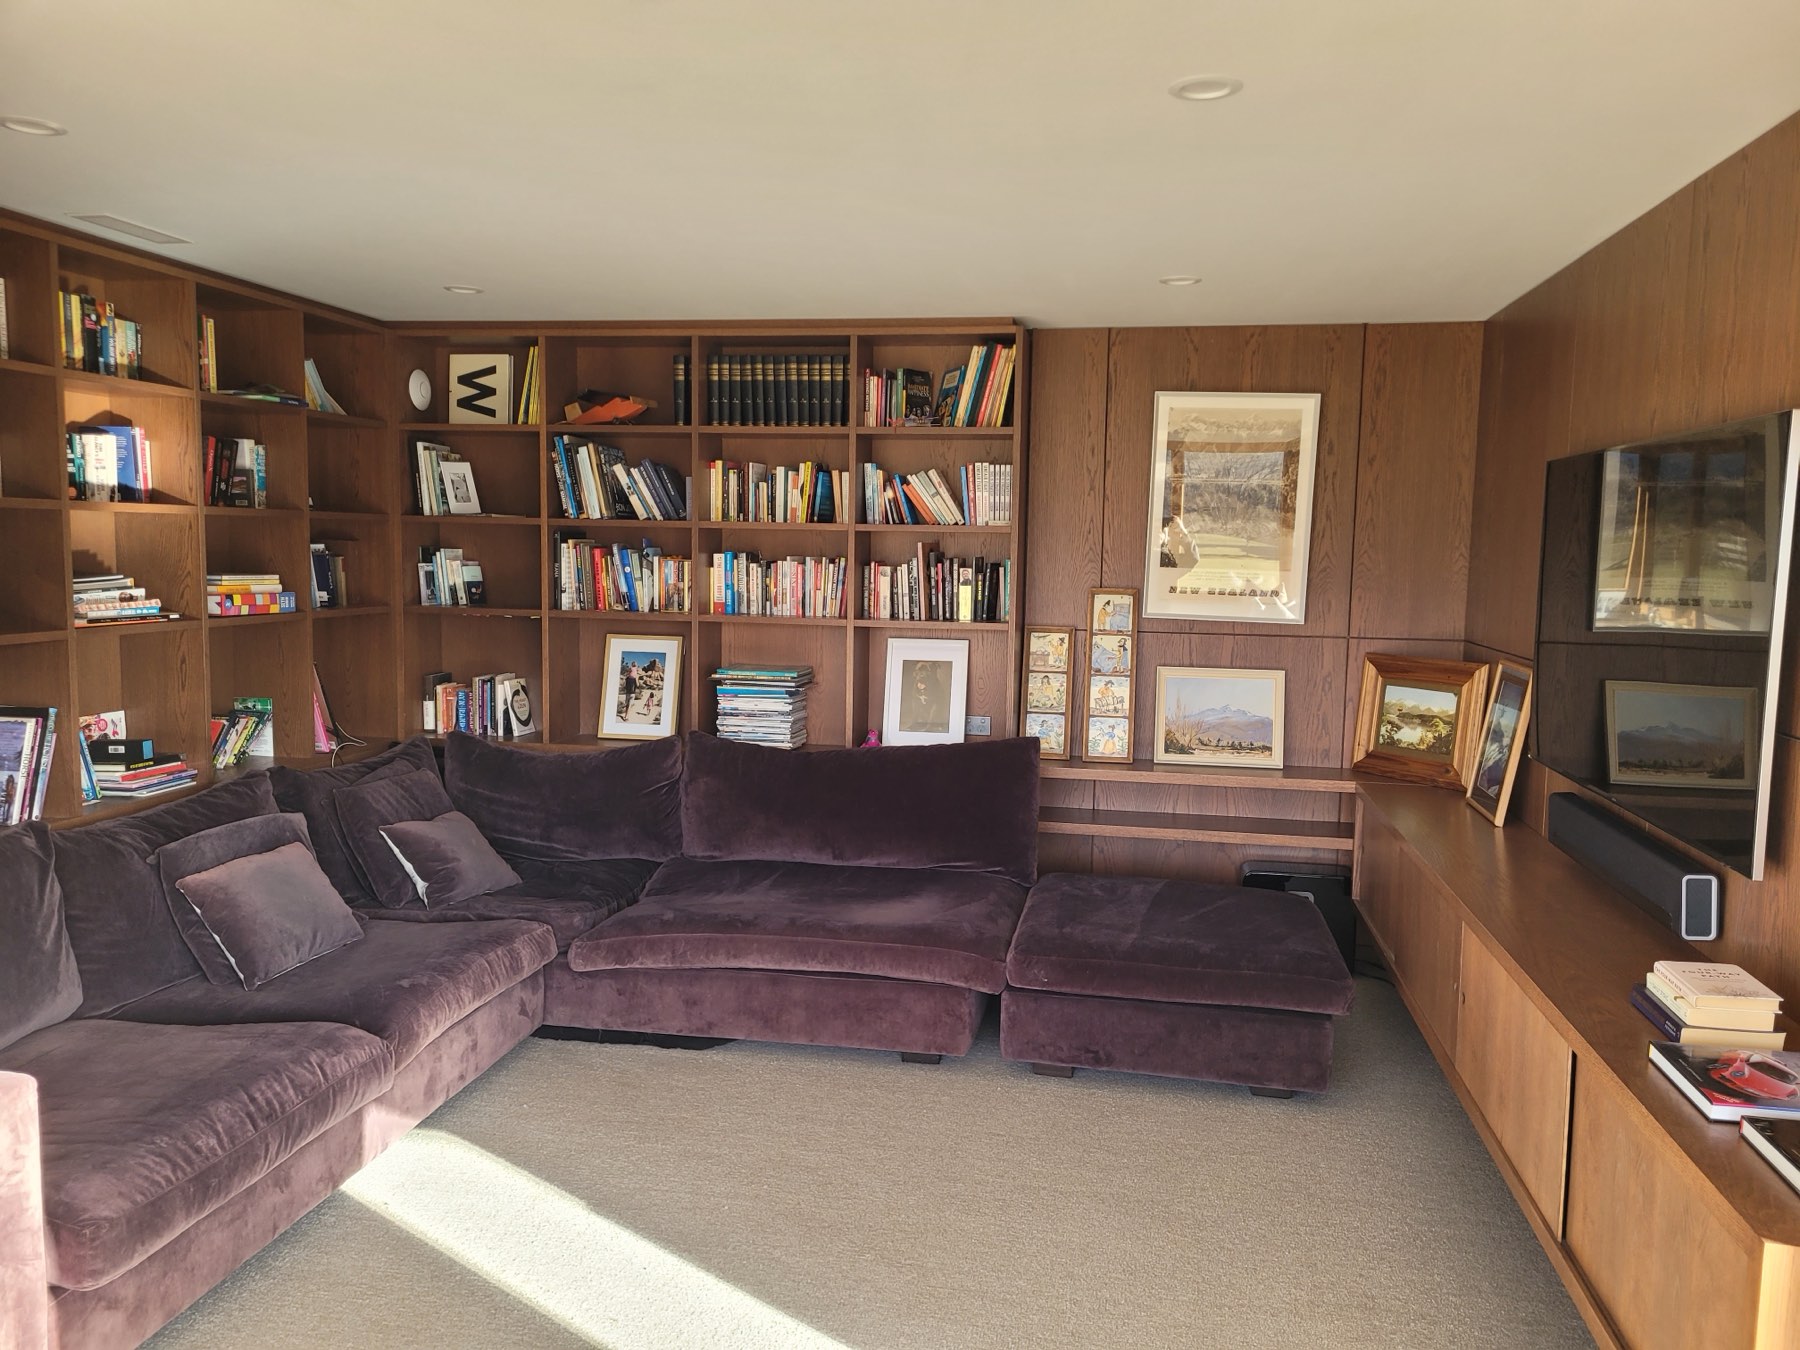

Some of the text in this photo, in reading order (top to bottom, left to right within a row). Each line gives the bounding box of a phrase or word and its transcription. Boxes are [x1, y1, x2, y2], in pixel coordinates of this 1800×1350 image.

[457, 365, 497, 418] W
[1169, 586, 1280, 597] NEW ZEALAND
